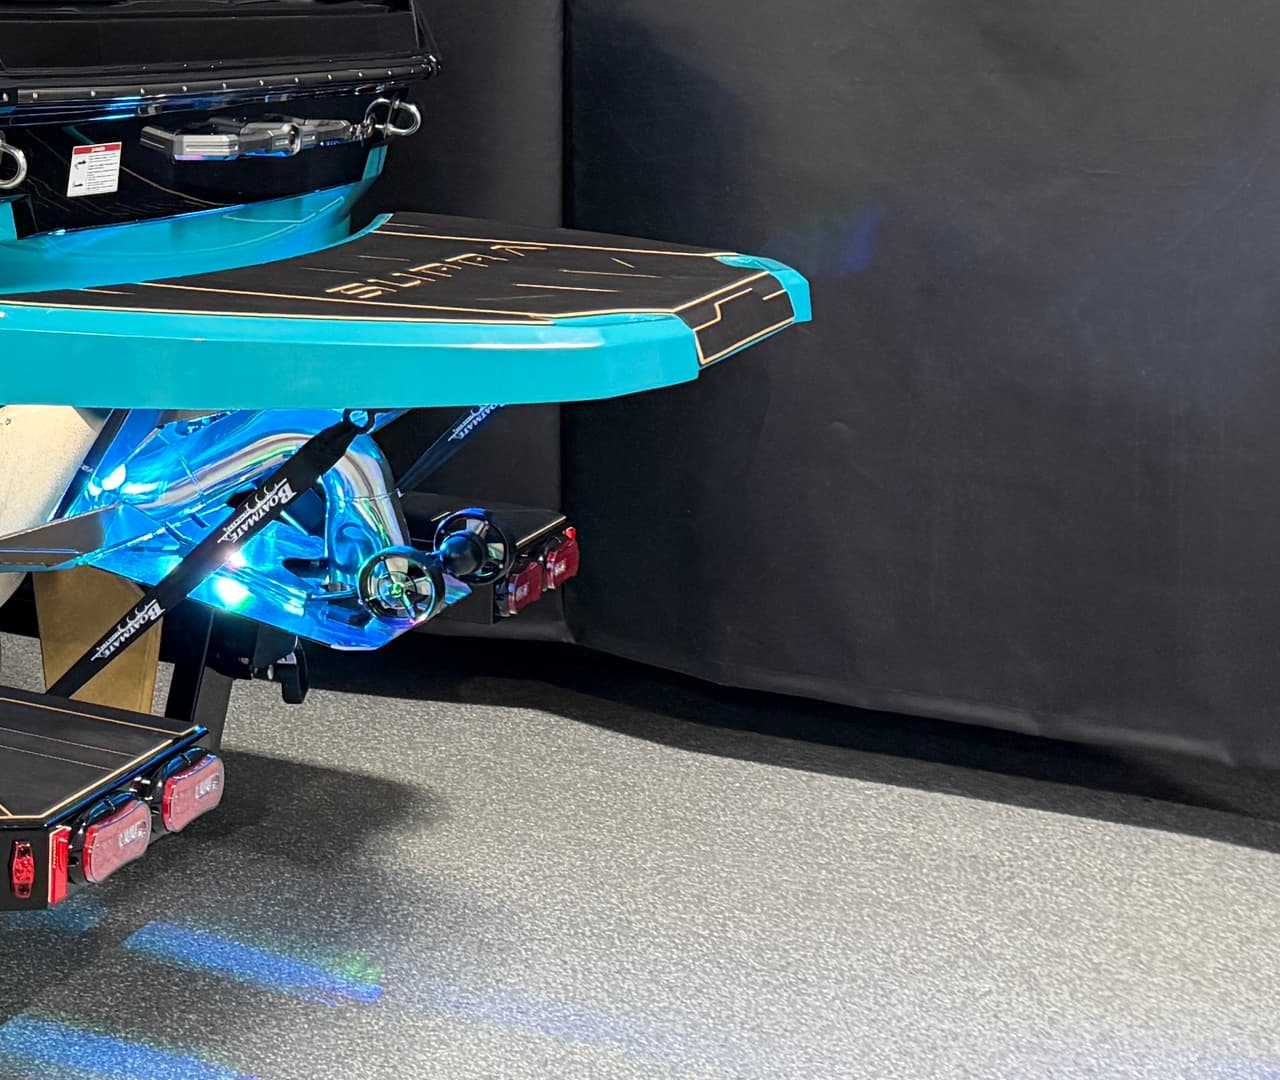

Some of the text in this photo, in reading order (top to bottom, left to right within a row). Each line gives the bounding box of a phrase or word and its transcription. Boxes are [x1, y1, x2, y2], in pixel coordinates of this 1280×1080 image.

[324, 244, 548, 300] SUPRA
[228, 481, 298, 544] BOATMATE
[100, 602, 166, 658] BOATMATE
